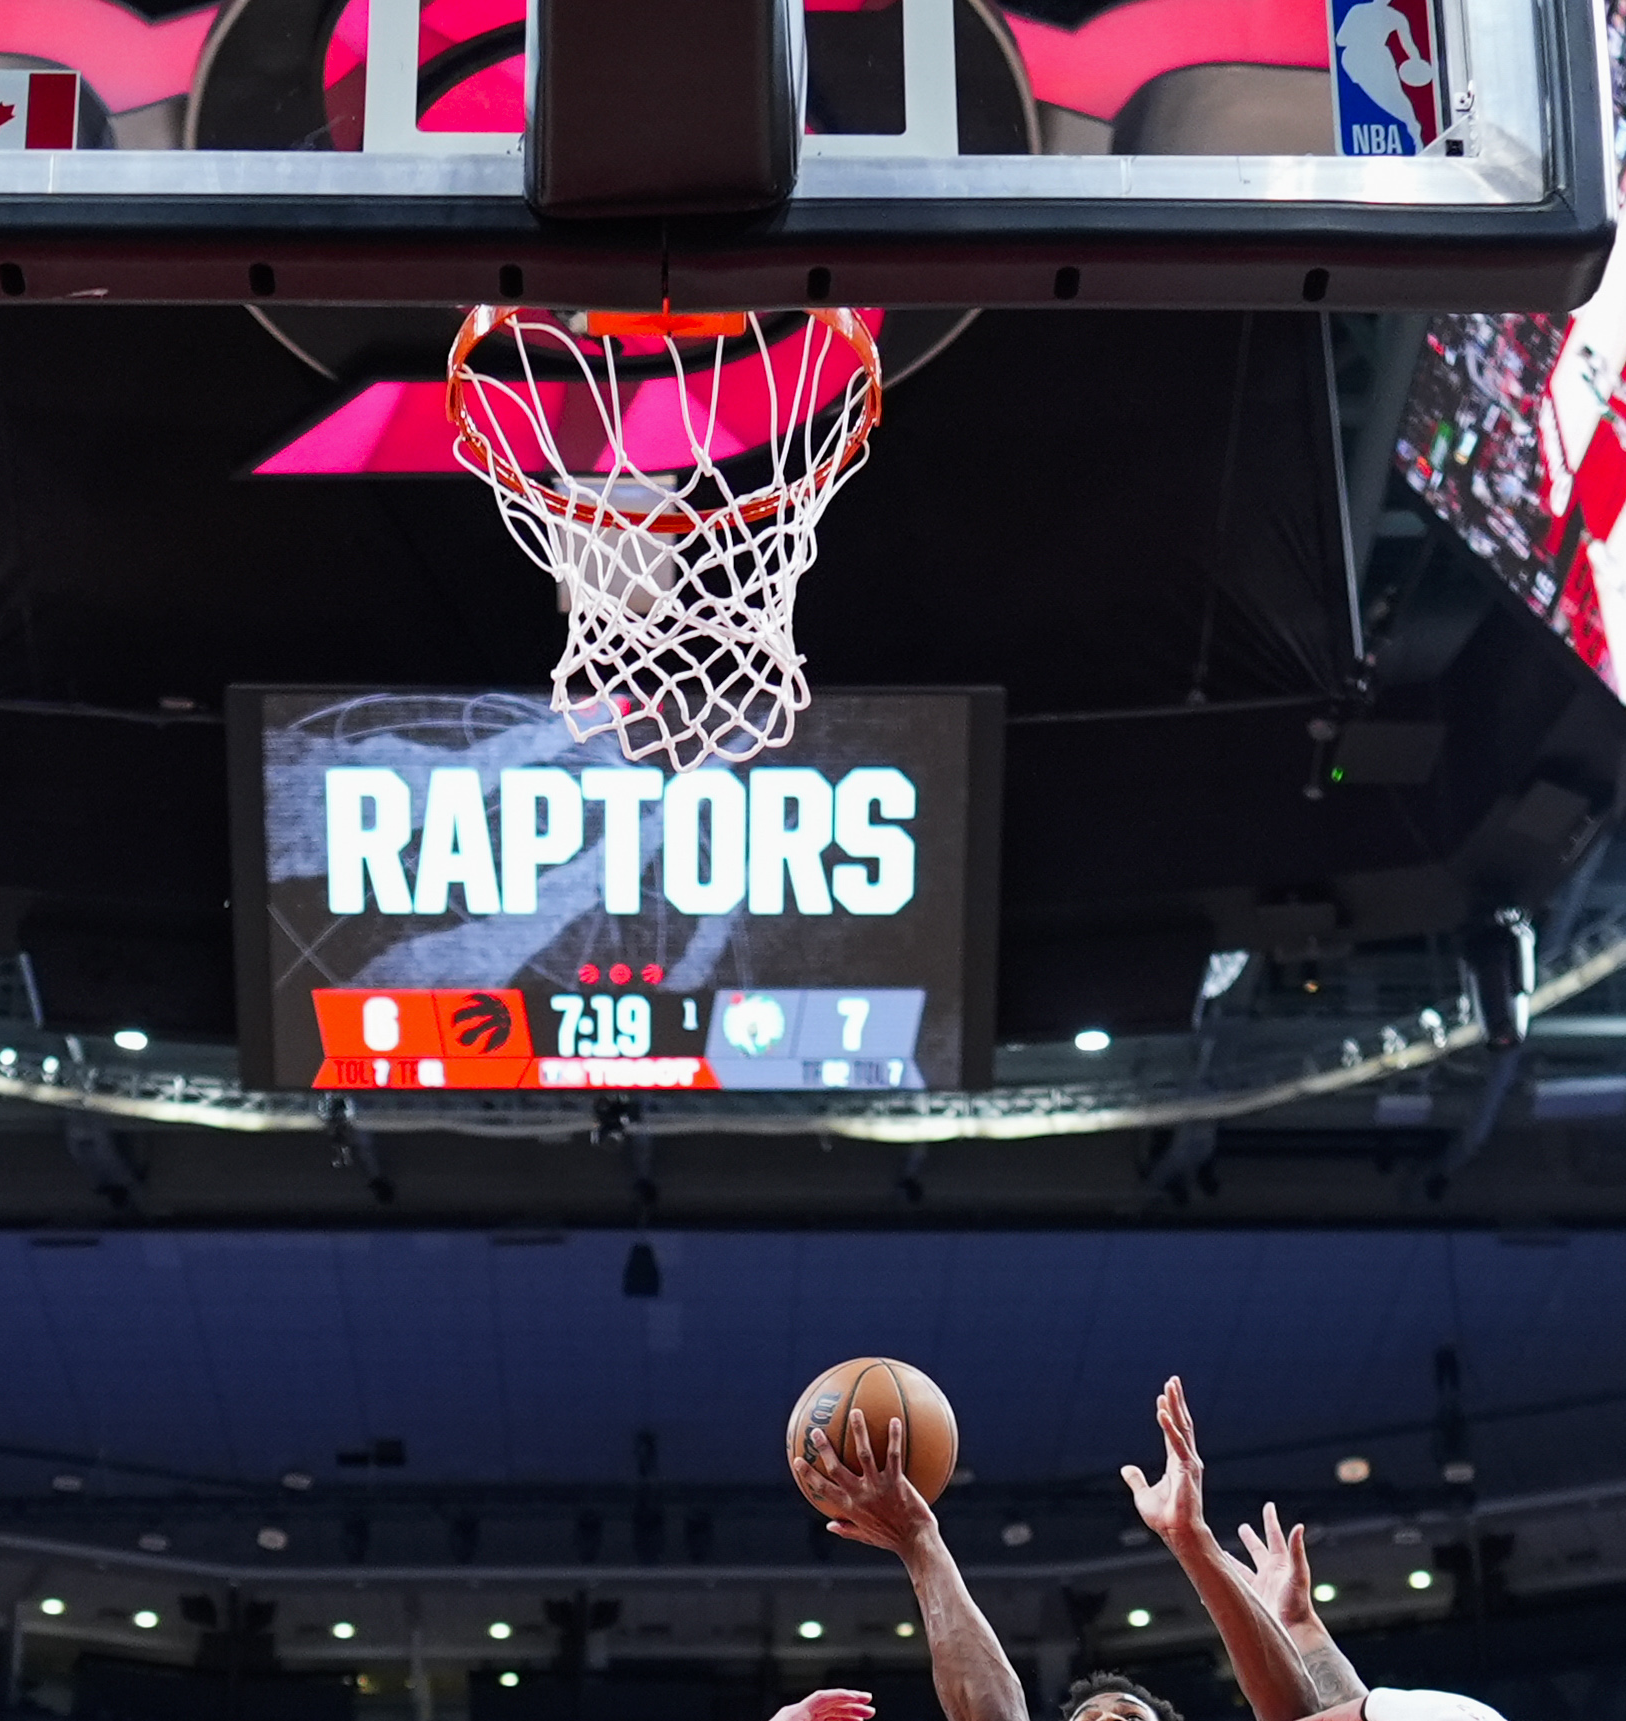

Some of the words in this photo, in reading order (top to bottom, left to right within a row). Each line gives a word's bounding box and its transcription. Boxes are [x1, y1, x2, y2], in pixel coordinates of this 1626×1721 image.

[1350, 123, 1407, 156] NBA
[325, 766, 918, 916] RAPTORS
[362, 996, 400, 1052] 6
[550, 993, 652, 1058] 7:19
[682, 997, 699, 1032] 1
[837, 997, 870, 1052] 7
